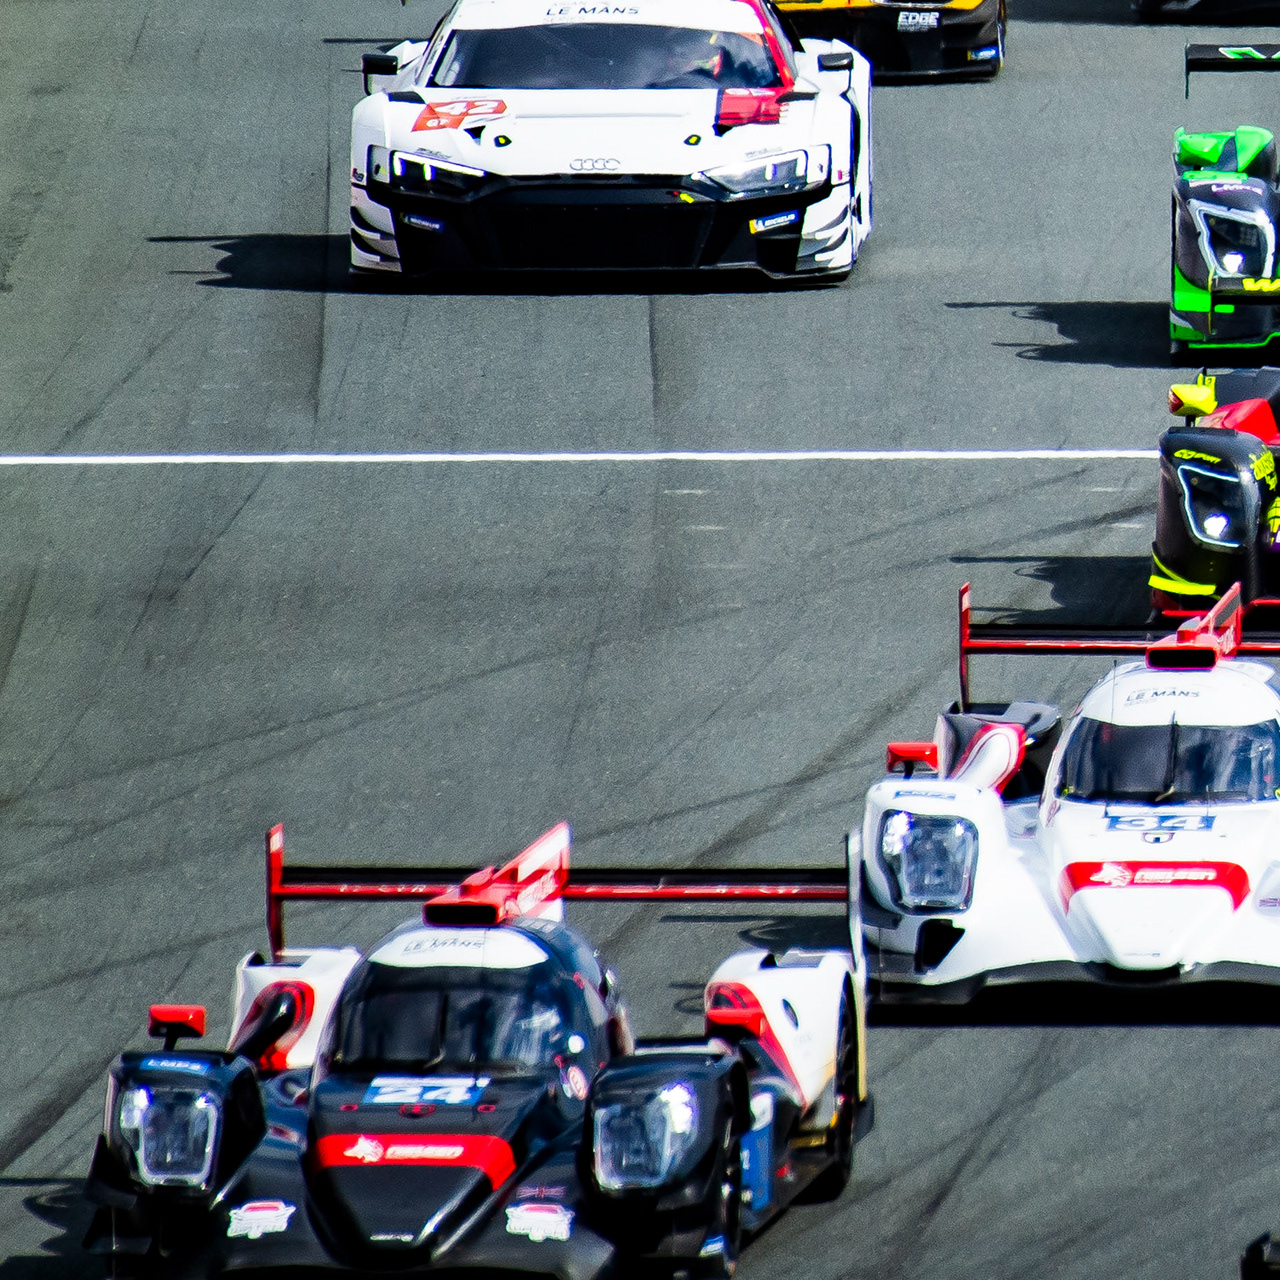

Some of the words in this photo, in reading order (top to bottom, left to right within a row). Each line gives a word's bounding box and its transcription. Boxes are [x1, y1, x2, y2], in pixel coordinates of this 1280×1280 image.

[546, 7, 572, 16] LE
[577, 6, 640, 15] MANS
[898, 12, 940, 25] EDGE
[435, 100, 494, 115] 42
[1125, 691, 1147, 703] LE
[1150, 689, 1201, 699] MANS
[1113, 815, 1206, 831] 34
[1135, 868, 1217, 881] NIELSEN
[403, 940, 424, 953] LE
[430, 938, 485, 950] MANS
[373, 1086, 471, 1104] 24
